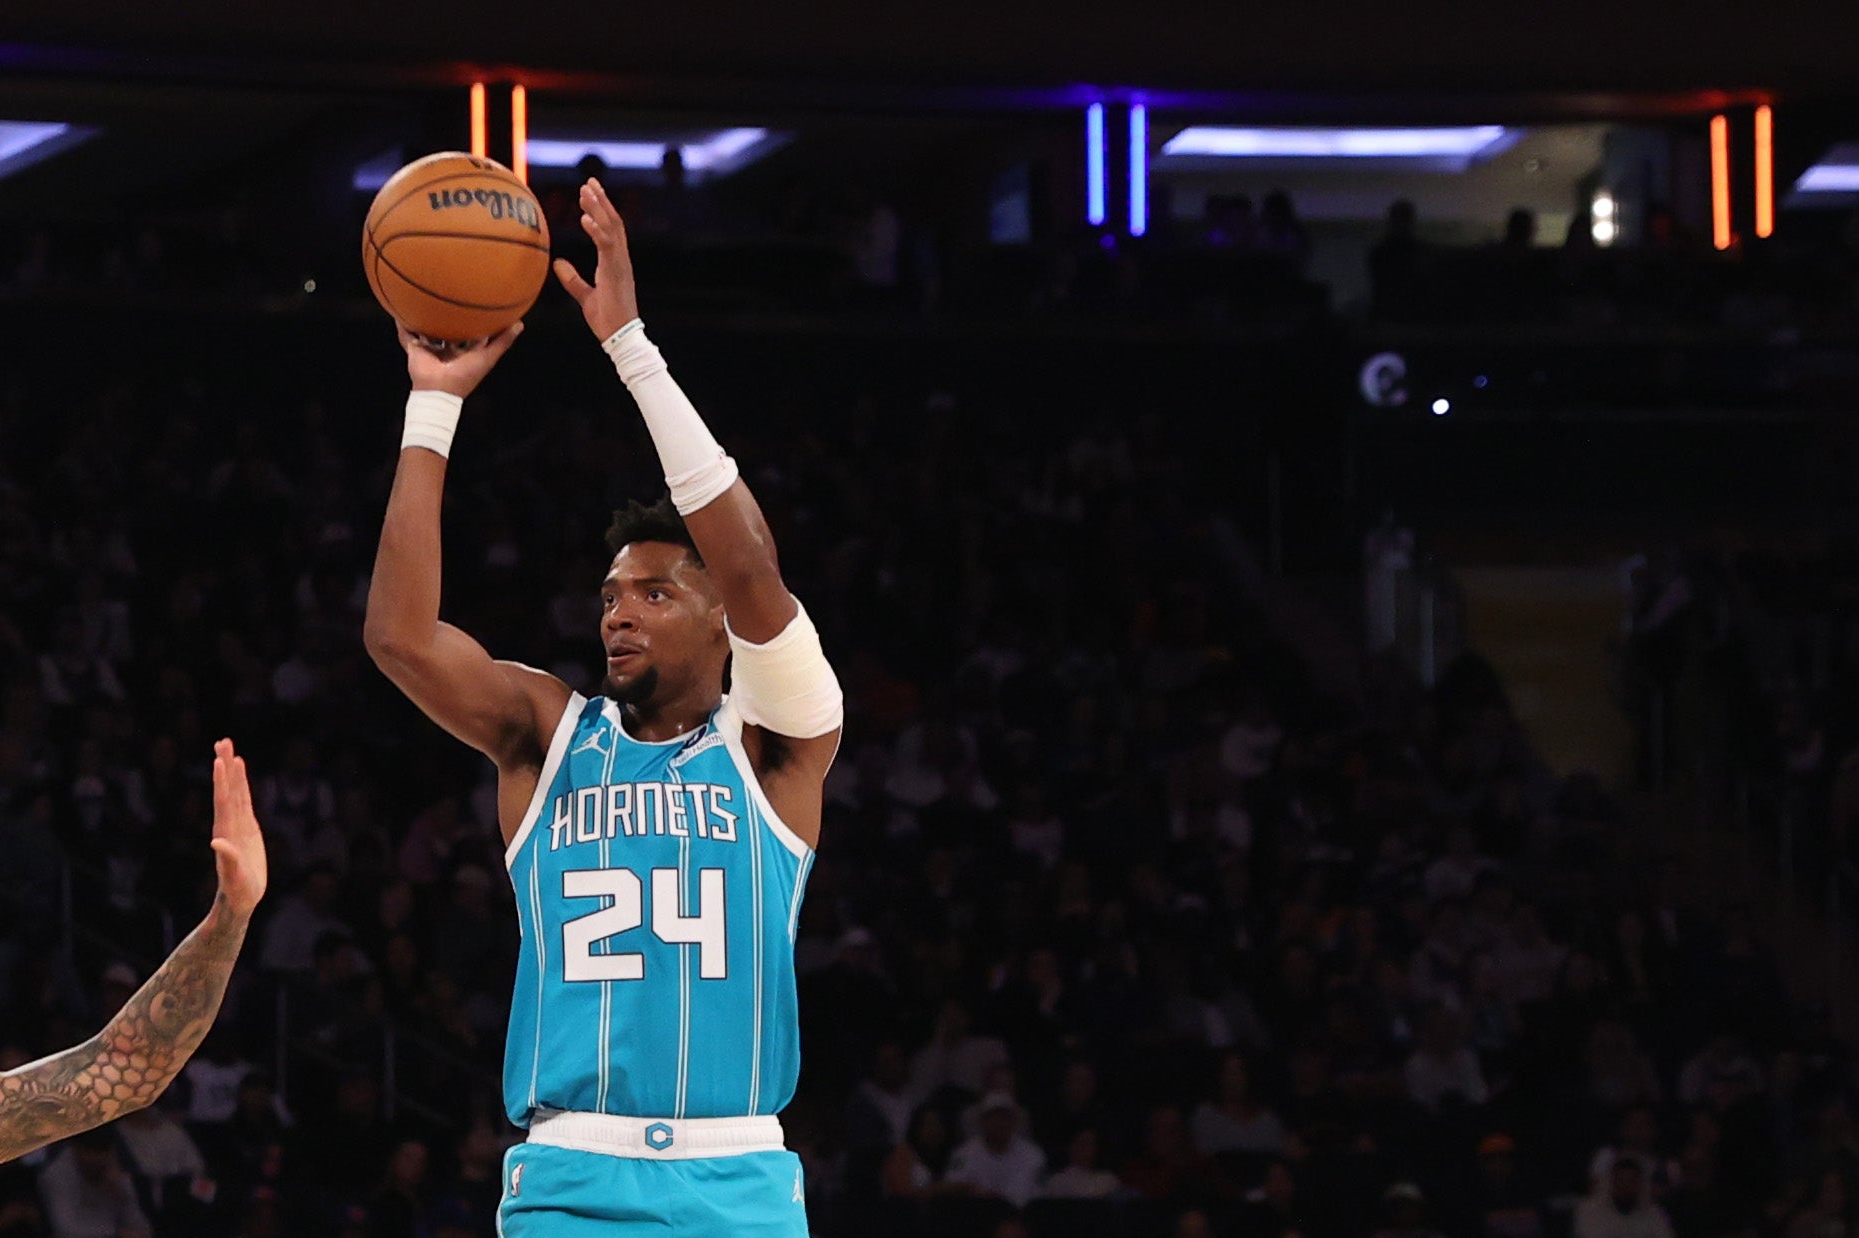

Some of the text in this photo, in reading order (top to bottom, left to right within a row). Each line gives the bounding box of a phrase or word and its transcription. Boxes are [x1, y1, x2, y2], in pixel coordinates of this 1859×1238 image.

[428, 188, 541, 234] Wilson
[548, 782, 740, 851] HORNETS
[562, 867, 728, 983] 24
